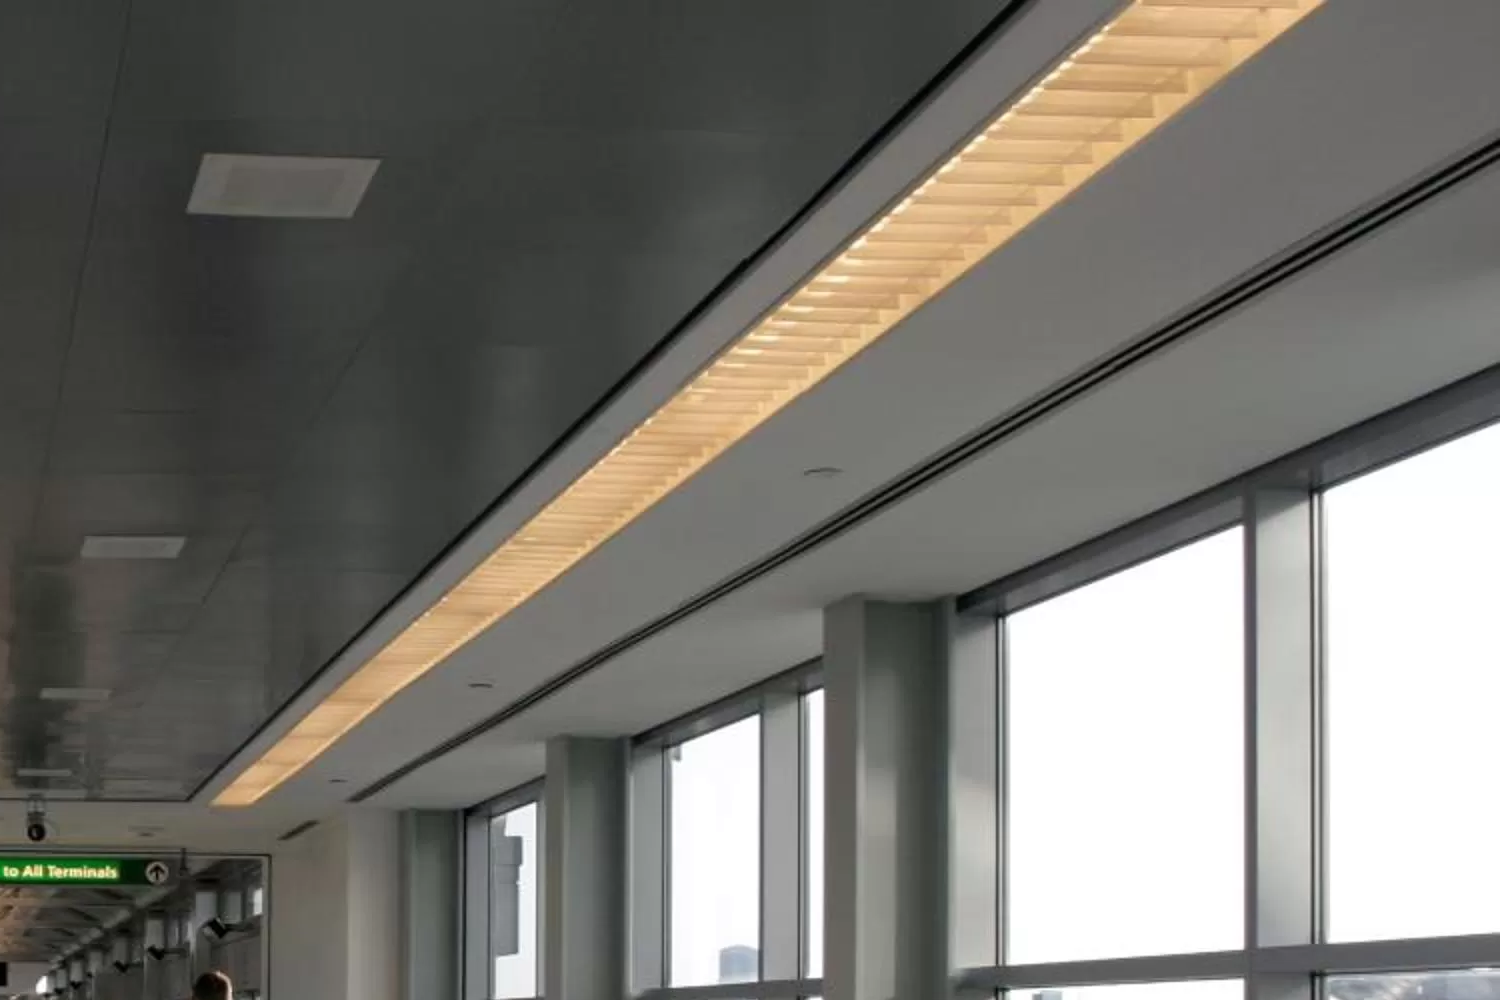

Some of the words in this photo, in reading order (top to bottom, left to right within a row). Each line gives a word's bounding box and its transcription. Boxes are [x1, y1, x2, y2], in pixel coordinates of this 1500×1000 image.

[3, 865, 19, 877] to
[22, 864, 43, 877] All
[48, 865, 118, 879] Terminals
